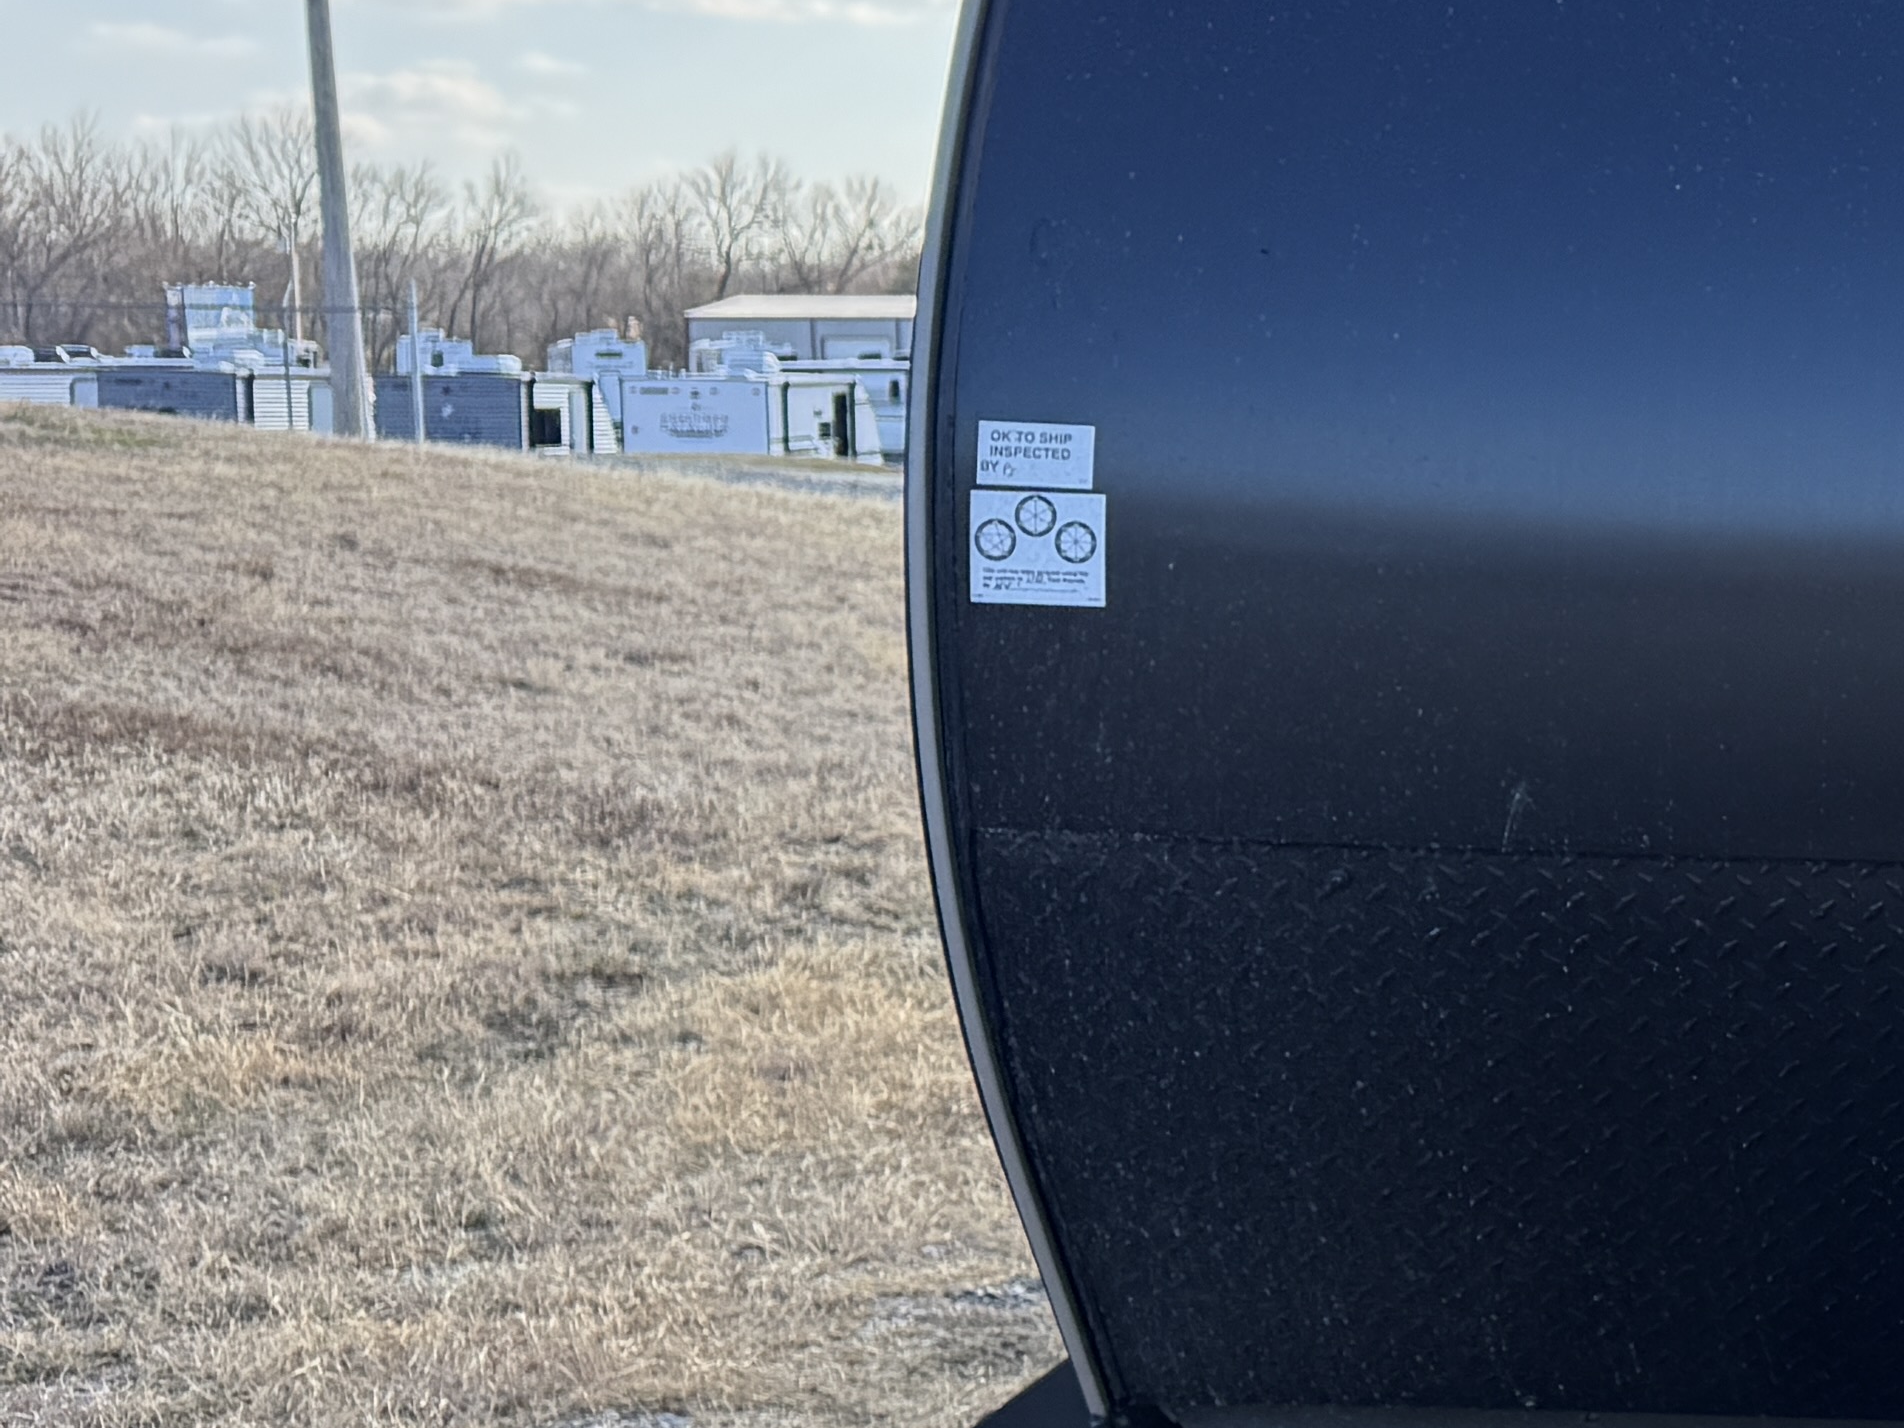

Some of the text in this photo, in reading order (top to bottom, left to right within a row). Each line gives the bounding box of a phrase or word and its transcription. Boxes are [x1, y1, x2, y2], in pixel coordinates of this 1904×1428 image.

[990, 429, 1073, 445] OK TO SHIP
[989, 445, 1071, 460] INSPECTED
[980, 459, 999, 472] BY
